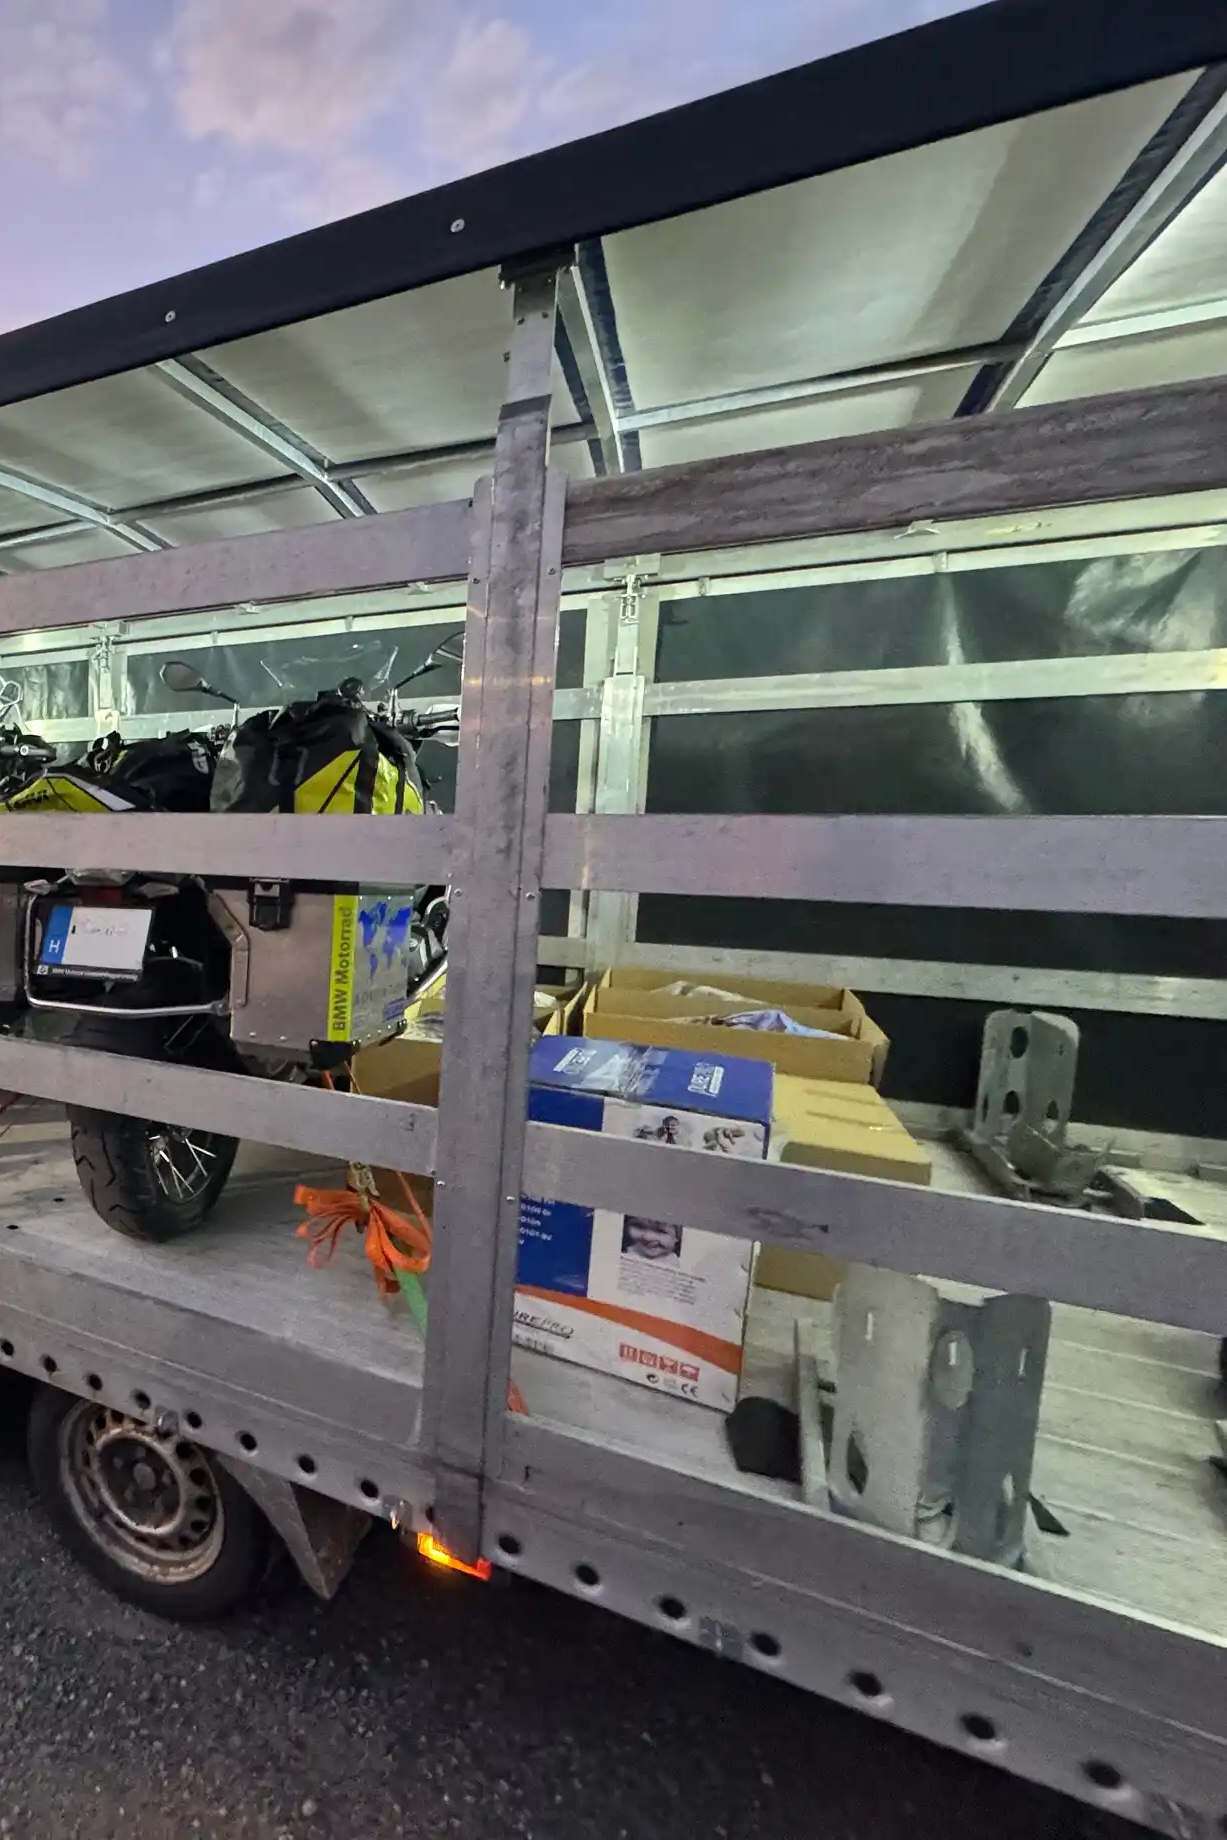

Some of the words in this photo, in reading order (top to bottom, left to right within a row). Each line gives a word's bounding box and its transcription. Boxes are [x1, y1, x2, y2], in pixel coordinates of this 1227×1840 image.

[48, 939, 61, 954] H
[335, 906, 352, 984] Motorrad
[333, 989, 348, 1031] BMW
